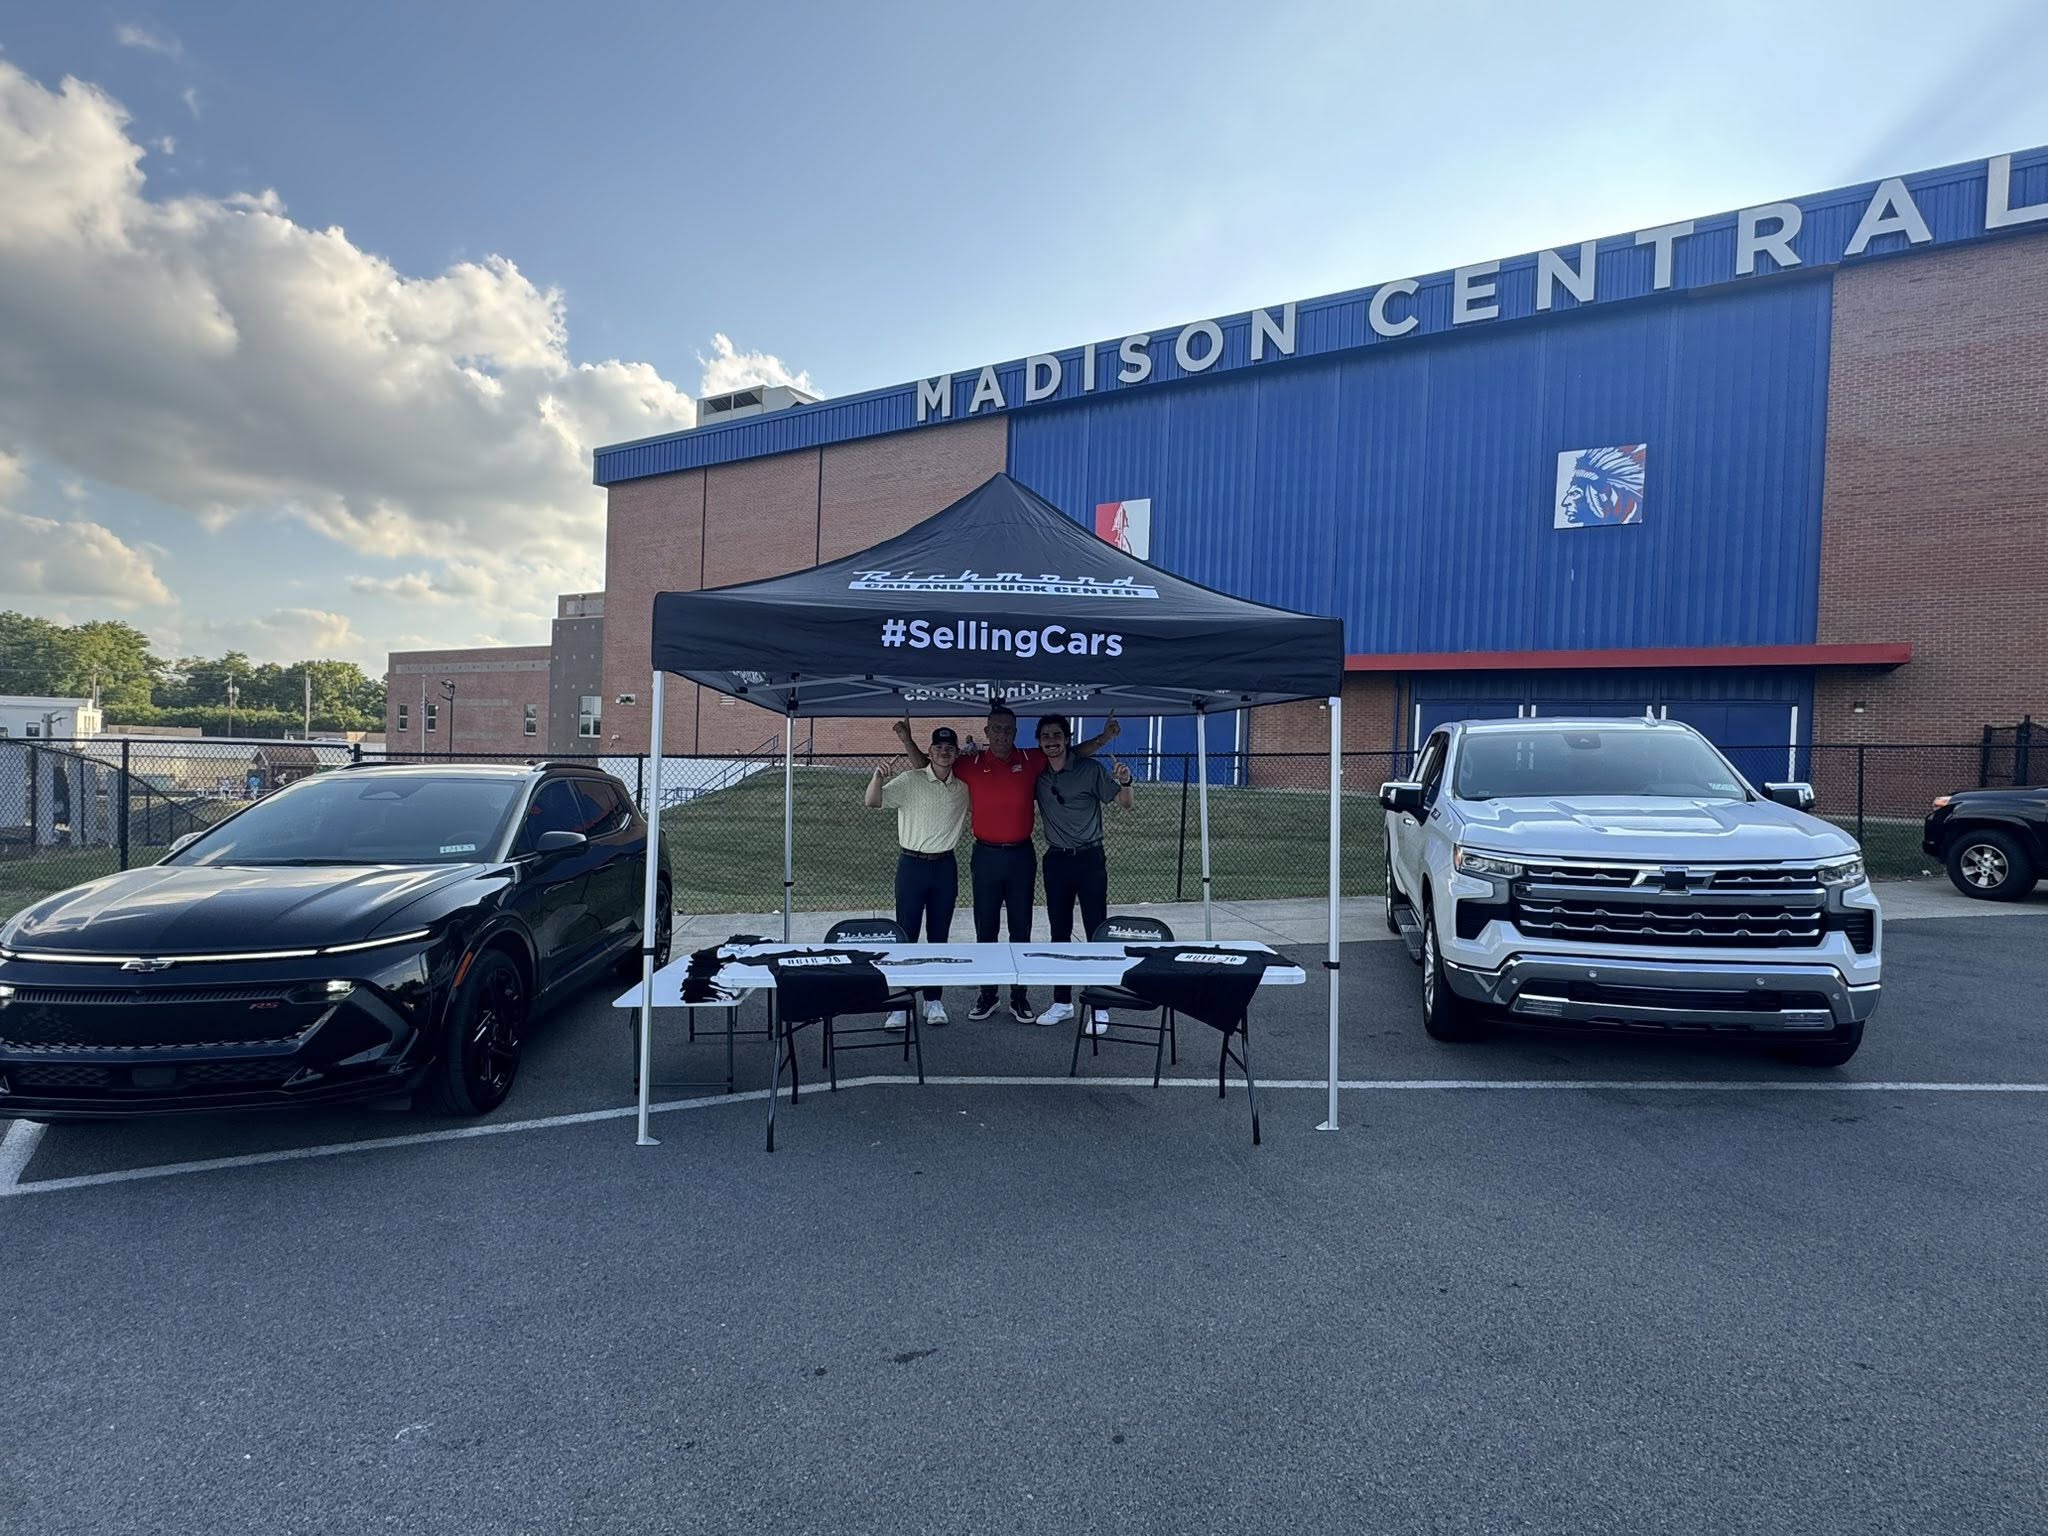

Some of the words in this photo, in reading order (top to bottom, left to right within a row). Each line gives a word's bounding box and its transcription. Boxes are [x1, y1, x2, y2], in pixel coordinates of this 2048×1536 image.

[916, 302, 1297, 422] MADISON
[1369, 155, 2048, 336] CENTRAL
[853, 570, 1155, 588] Richmond
[972, 584, 1048, 592] TRUCK
[1054, 586, 1140, 596] CENTER
[881, 618, 1123, 658] #SellingCars
